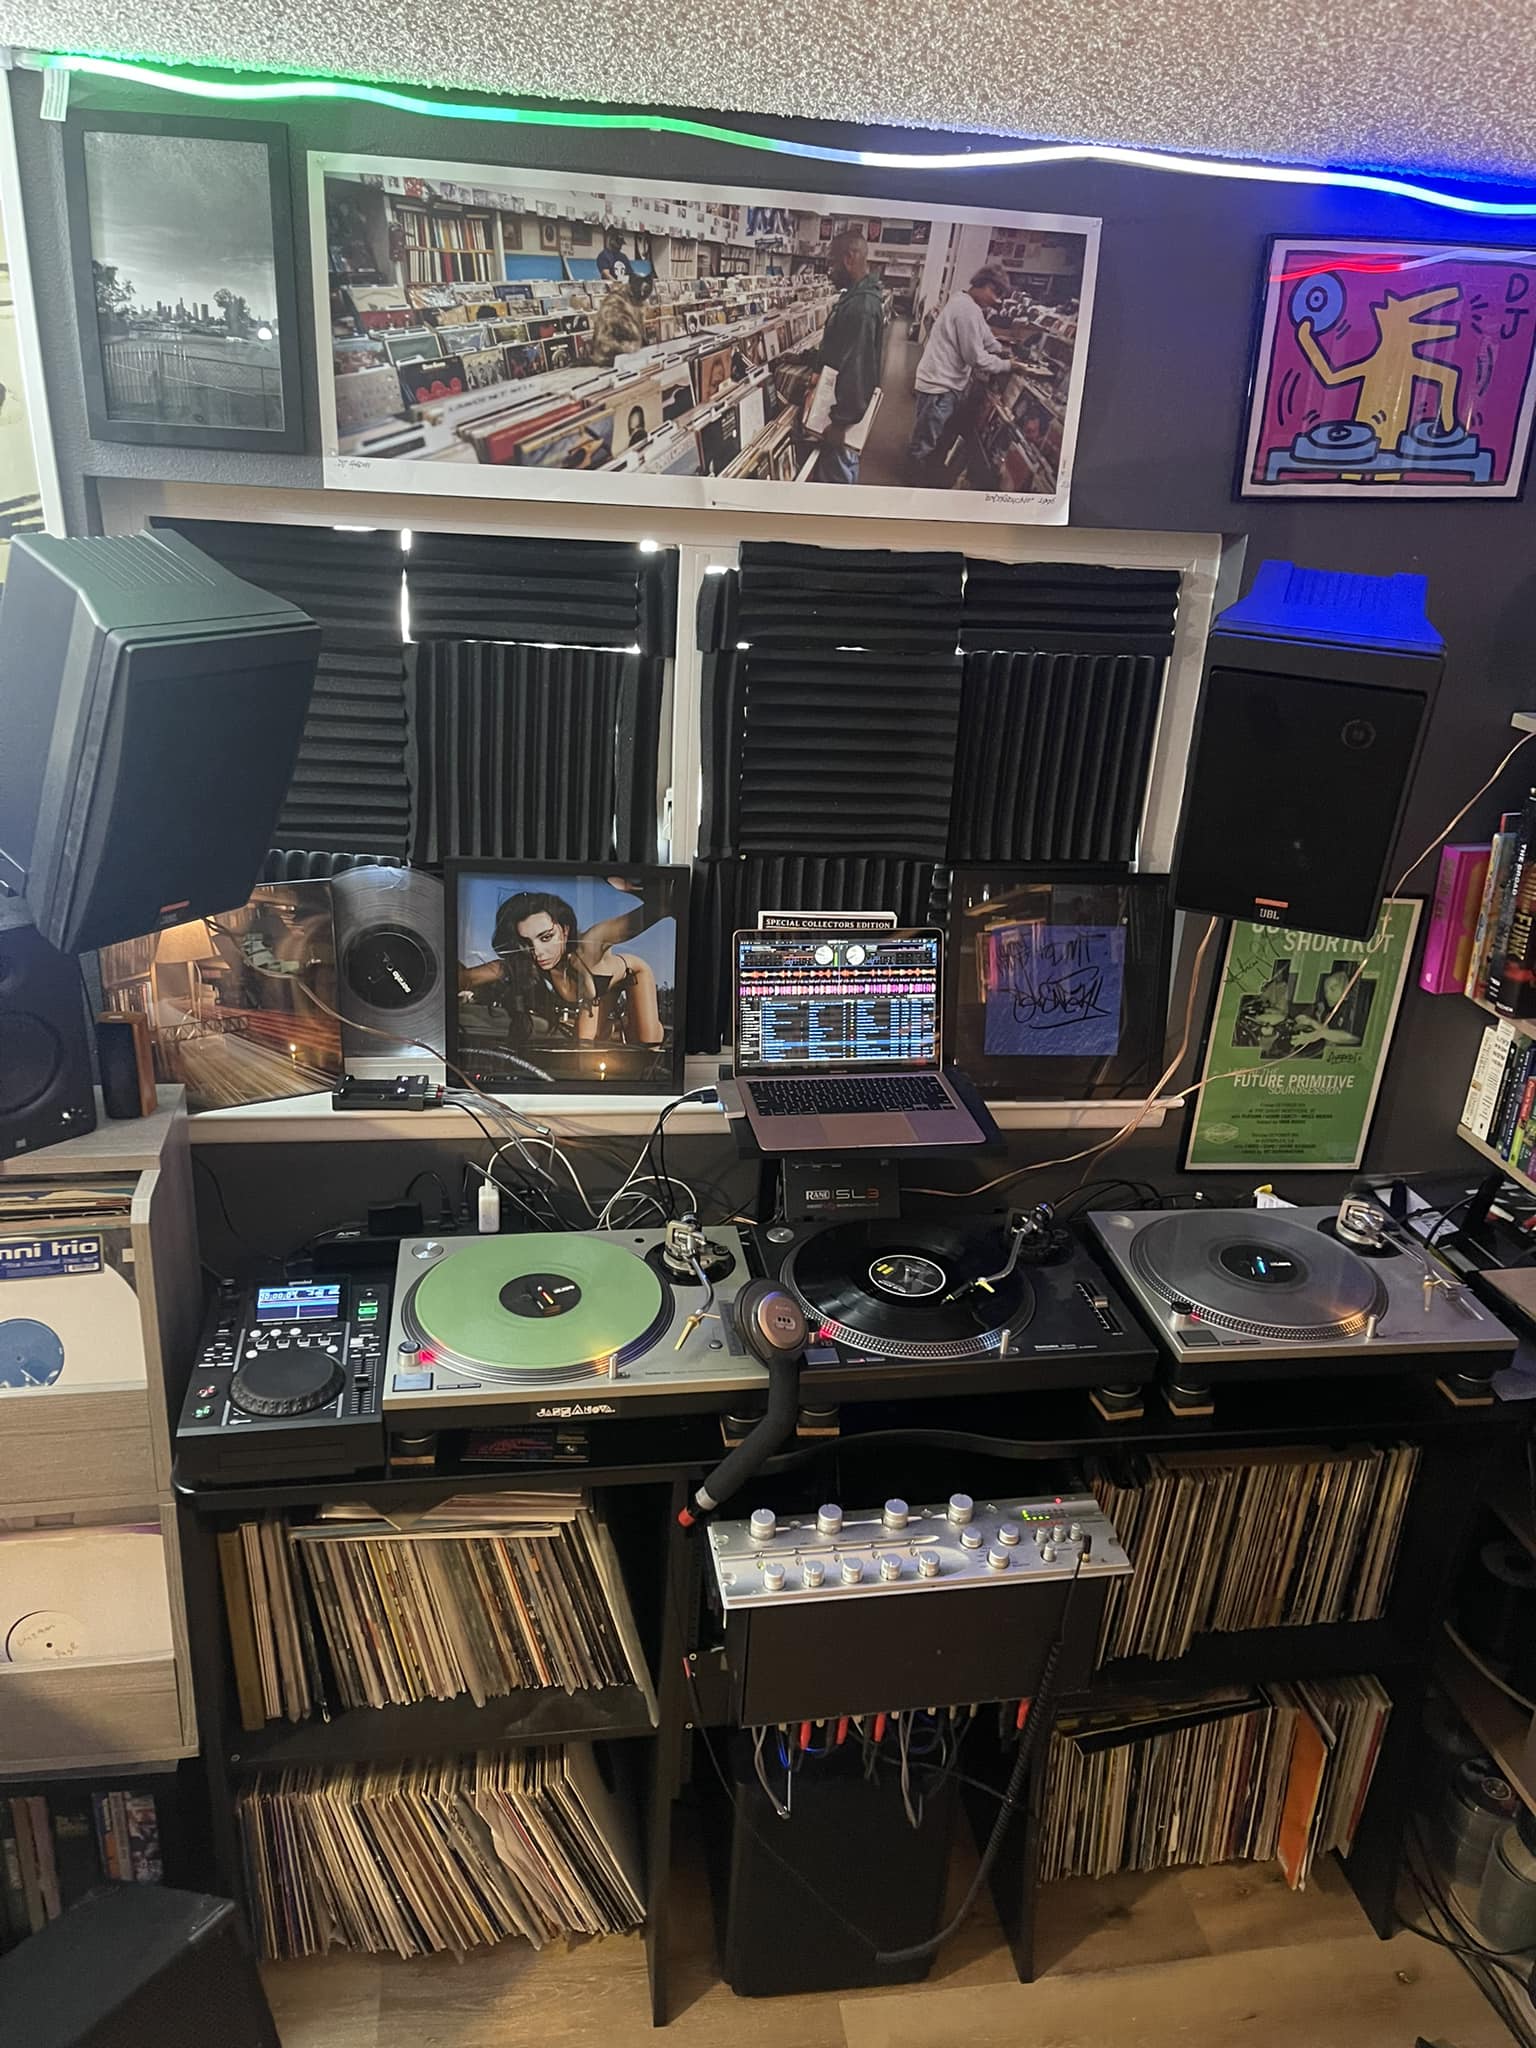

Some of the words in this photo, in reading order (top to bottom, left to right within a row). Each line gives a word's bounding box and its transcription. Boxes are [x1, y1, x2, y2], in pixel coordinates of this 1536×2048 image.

[765, 918, 800, 927] SPECIAL
[801, 919, 854, 928] COLLECTORS
[856, 920, 890, 929] EDITION
[1508, 912, 1533, 962] FUNK
[1233, 1073, 1285, 1088] FUTURE
[1288, 1073, 1355, 1089] PRIMITIVE
[1268, 1085, 1343, 1096] SOUNDSESSION
[51, 1240, 98, 1257] trio
